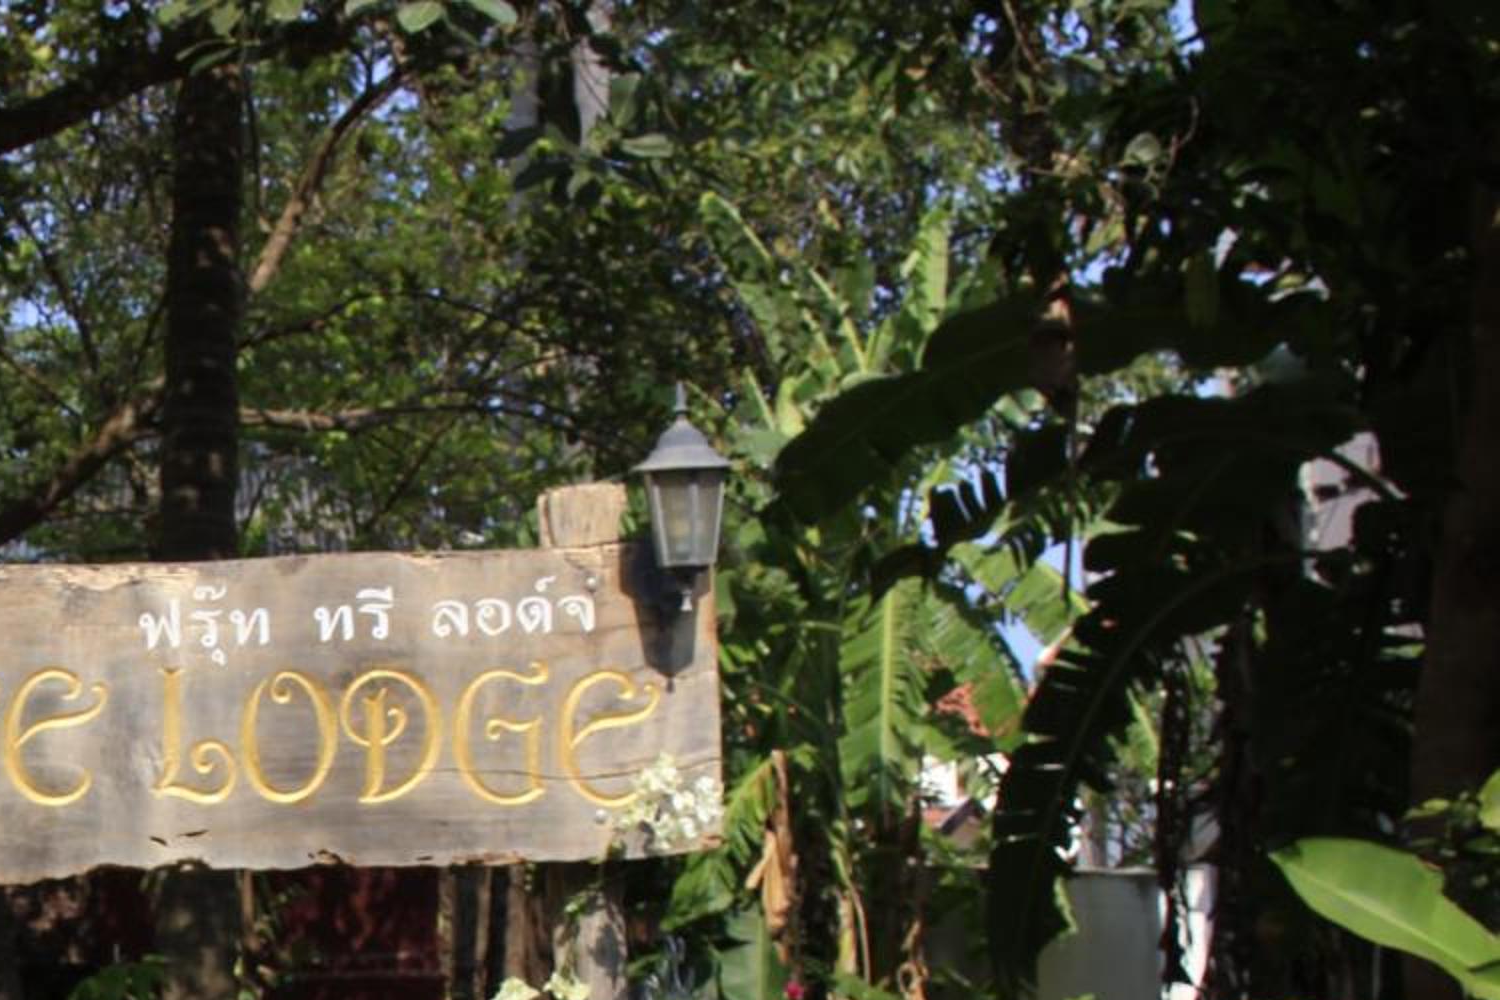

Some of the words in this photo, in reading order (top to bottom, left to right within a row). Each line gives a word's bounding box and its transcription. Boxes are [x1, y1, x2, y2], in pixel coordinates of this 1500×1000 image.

[314, 586, 394, 642] ทรี
[431, 575, 595, 637] ลอด์จ
[152, 661, 662, 806] LODGE
